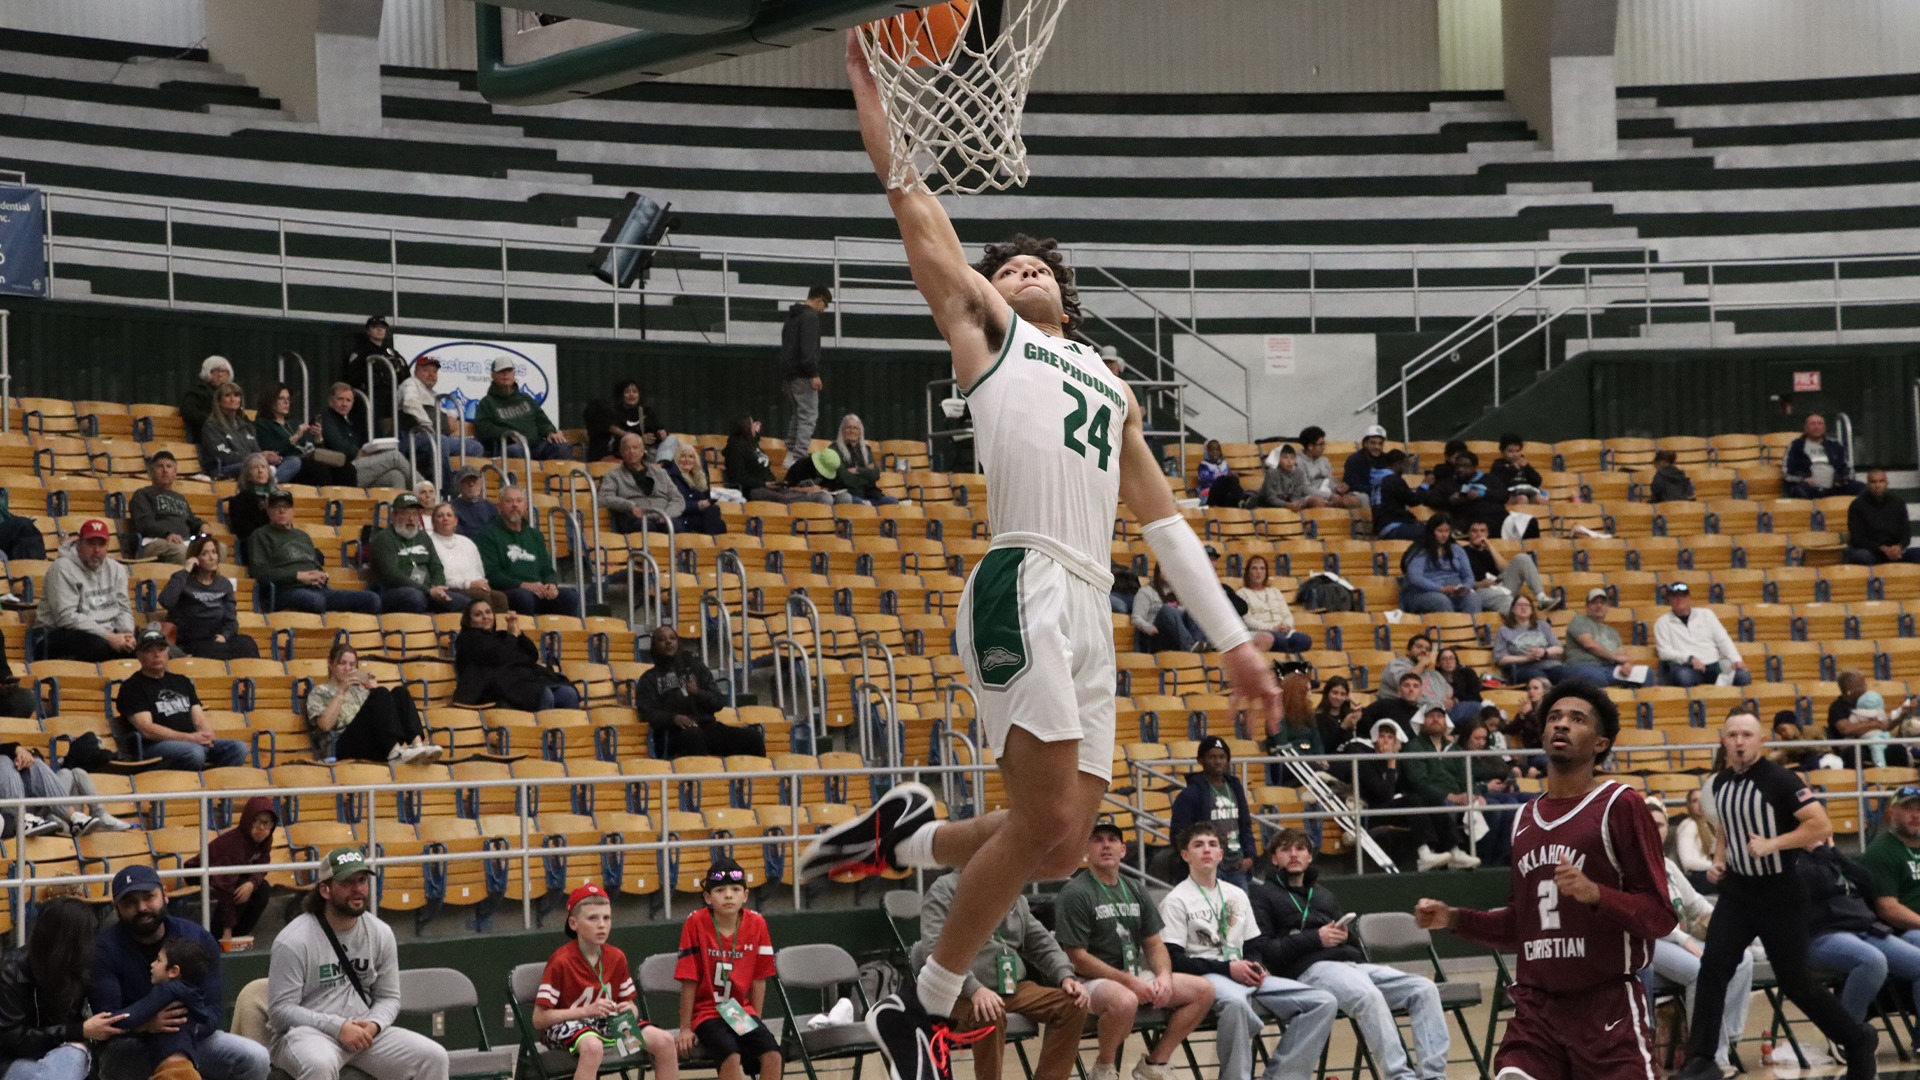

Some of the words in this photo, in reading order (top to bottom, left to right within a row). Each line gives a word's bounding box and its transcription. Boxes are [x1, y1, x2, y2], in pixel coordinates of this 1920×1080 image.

[439, 358, 482, 375] estern
[484, 360, 527, 377] Ses
[1063, 380, 1112, 472] 24
[91, 522, 103, 531] W
[337, 852, 362, 864] ROO
[1537, 879, 1561, 930] 2
[1524, 938, 1586, 961] CRISTIAN
[319, 958, 369, 978] ENU
[713, 962, 733, 1003] 5
